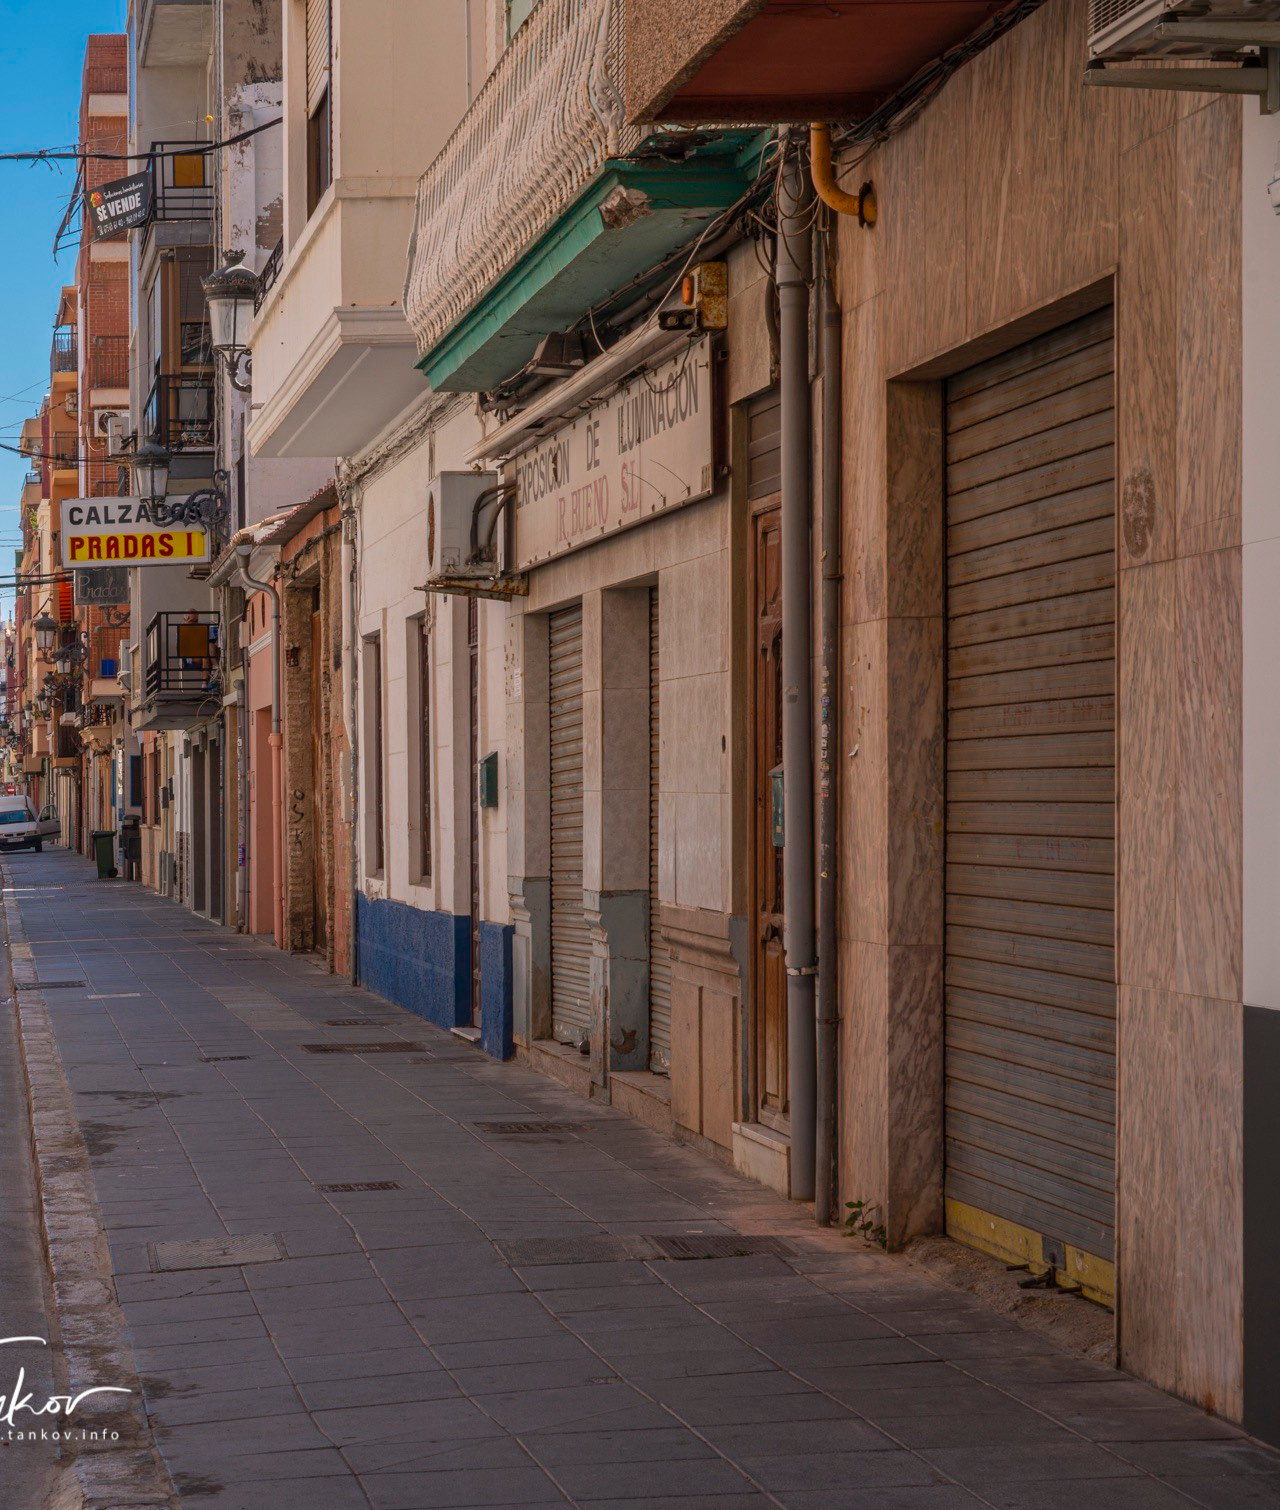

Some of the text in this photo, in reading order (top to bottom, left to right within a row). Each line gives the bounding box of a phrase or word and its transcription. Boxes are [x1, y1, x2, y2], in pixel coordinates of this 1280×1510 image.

[96, 204, 108, 222] SE
[107, 192, 141, 217] VENDE
[586, 420, 600, 471] DE
[571, 474, 609, 537] BUENO
[70, 533, 174, 561] PRADAS
